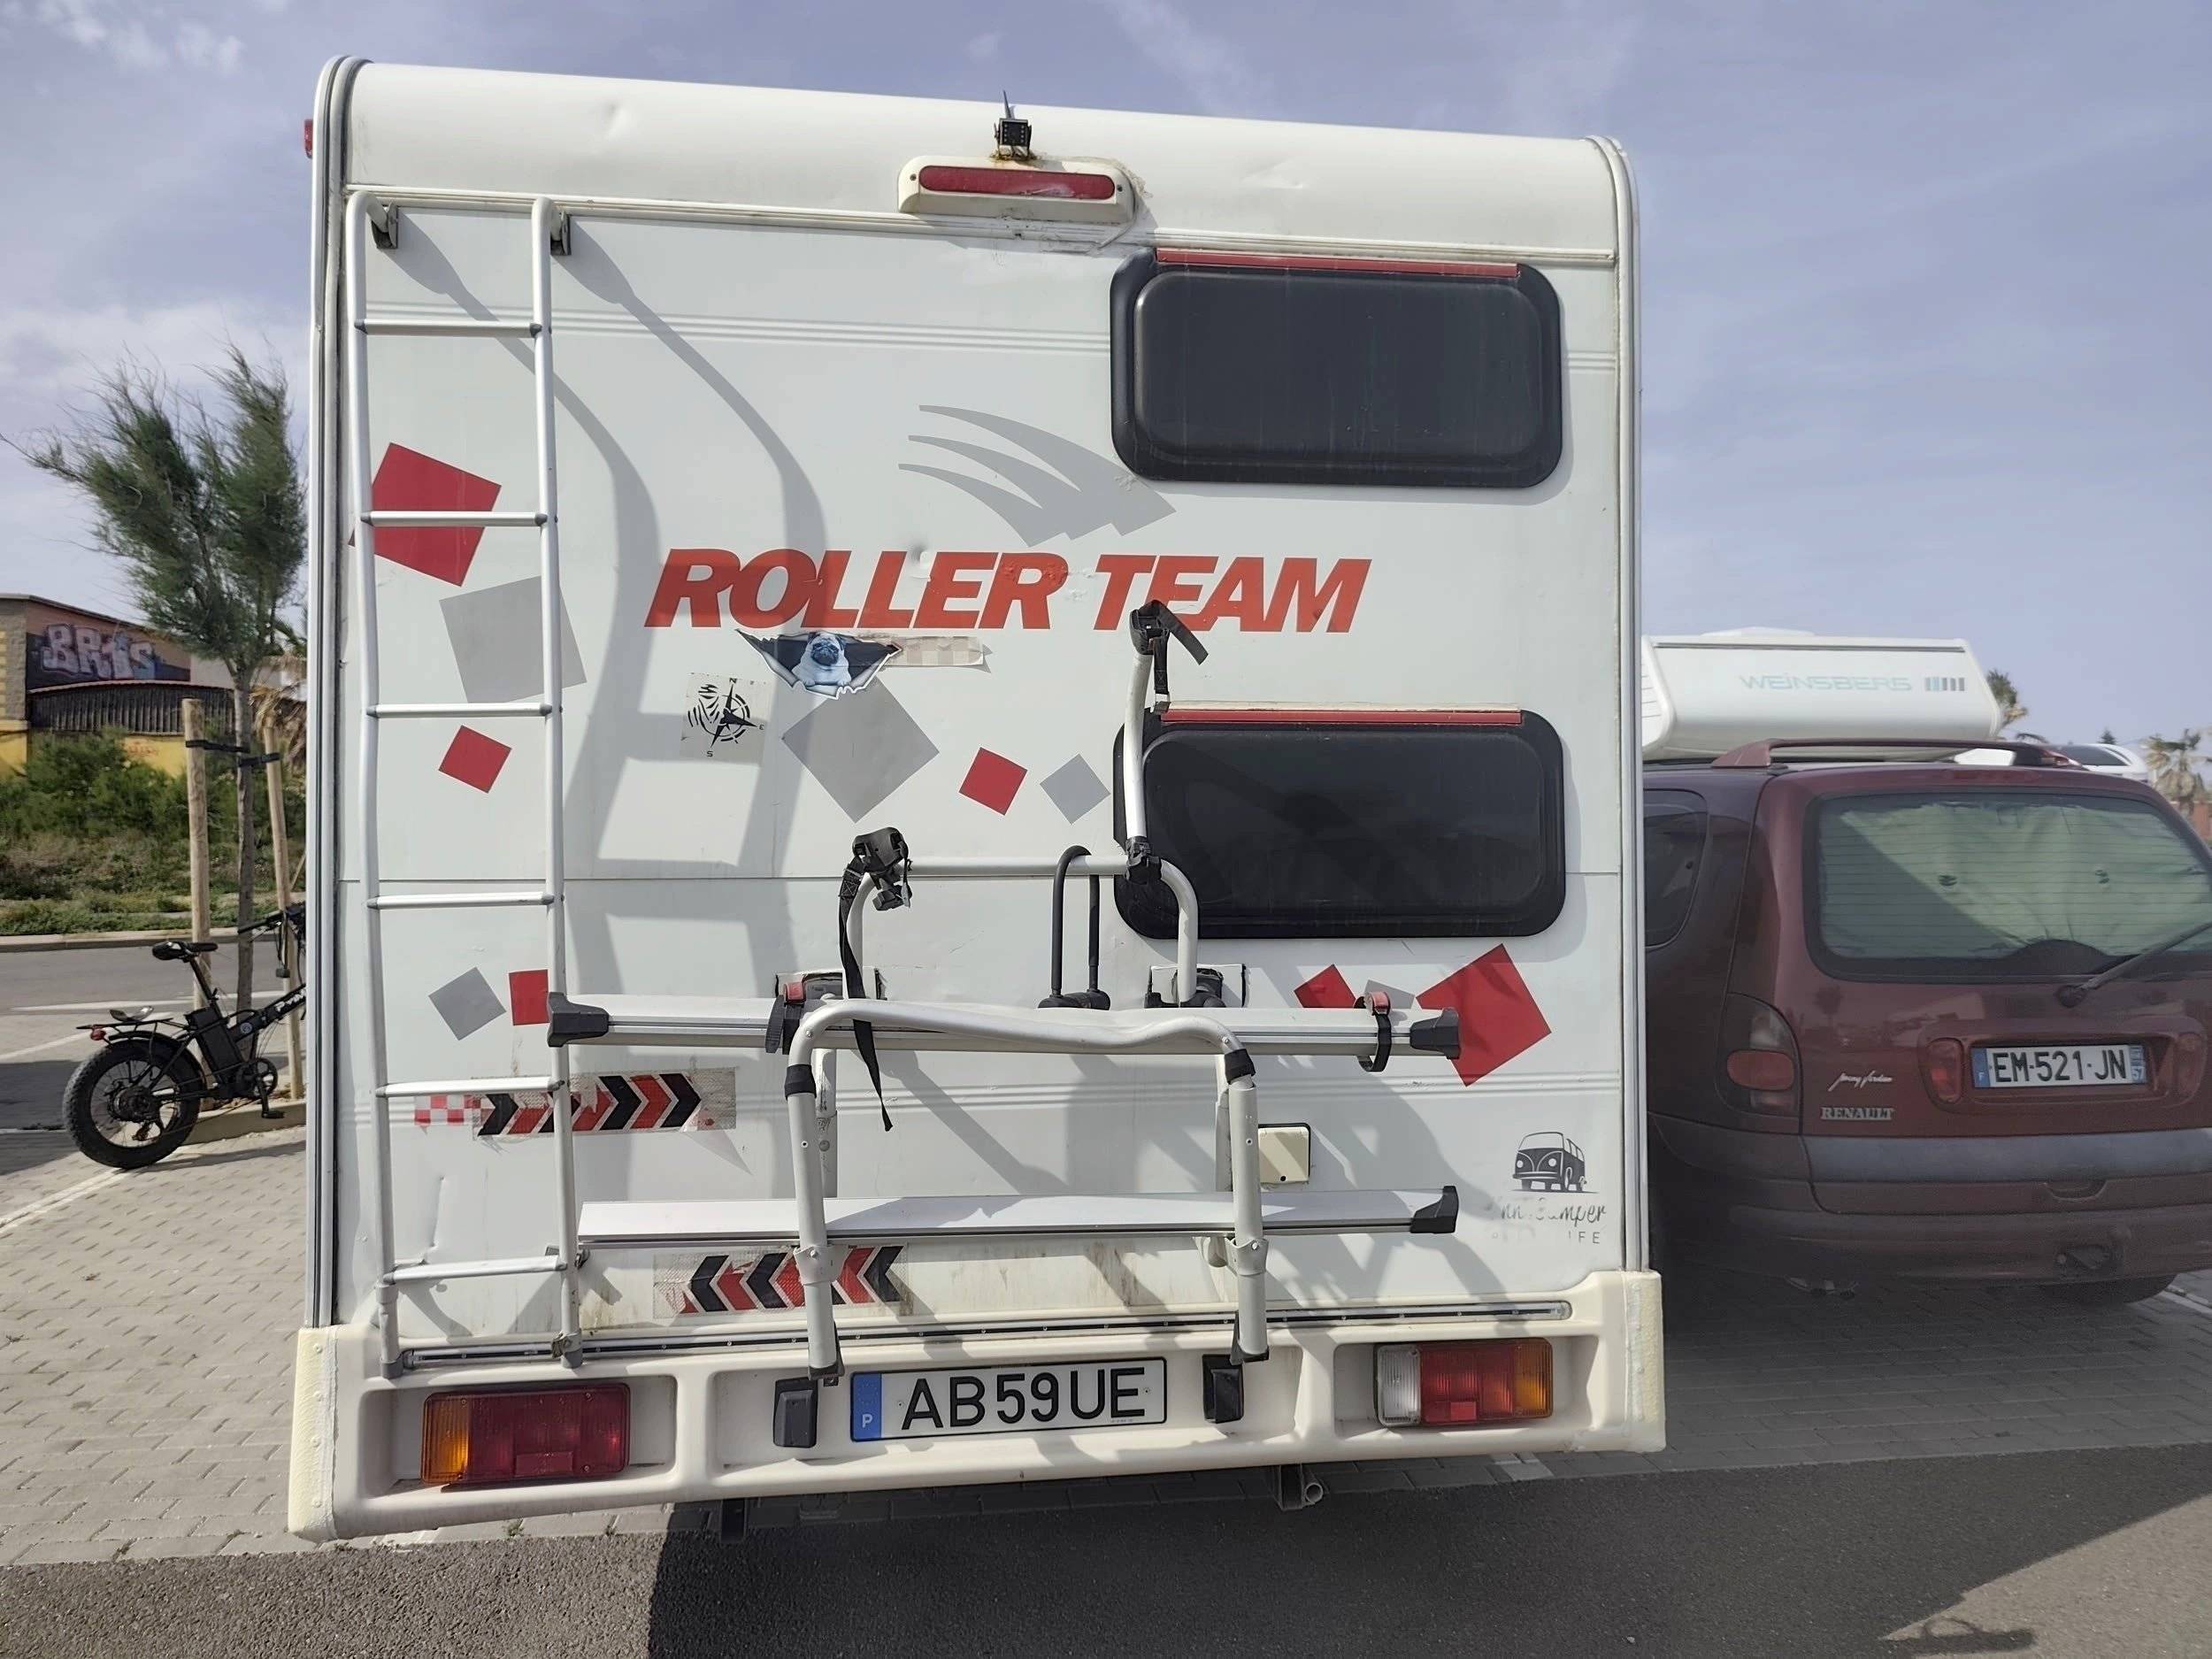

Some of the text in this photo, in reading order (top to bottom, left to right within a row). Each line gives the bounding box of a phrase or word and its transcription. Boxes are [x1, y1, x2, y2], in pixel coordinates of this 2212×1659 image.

[644, 549, 1373, 634] ROLLER TEAM
[1820, 1107, 1895, 1121] RENAULT
[861, 1413, 874, 1429] P
